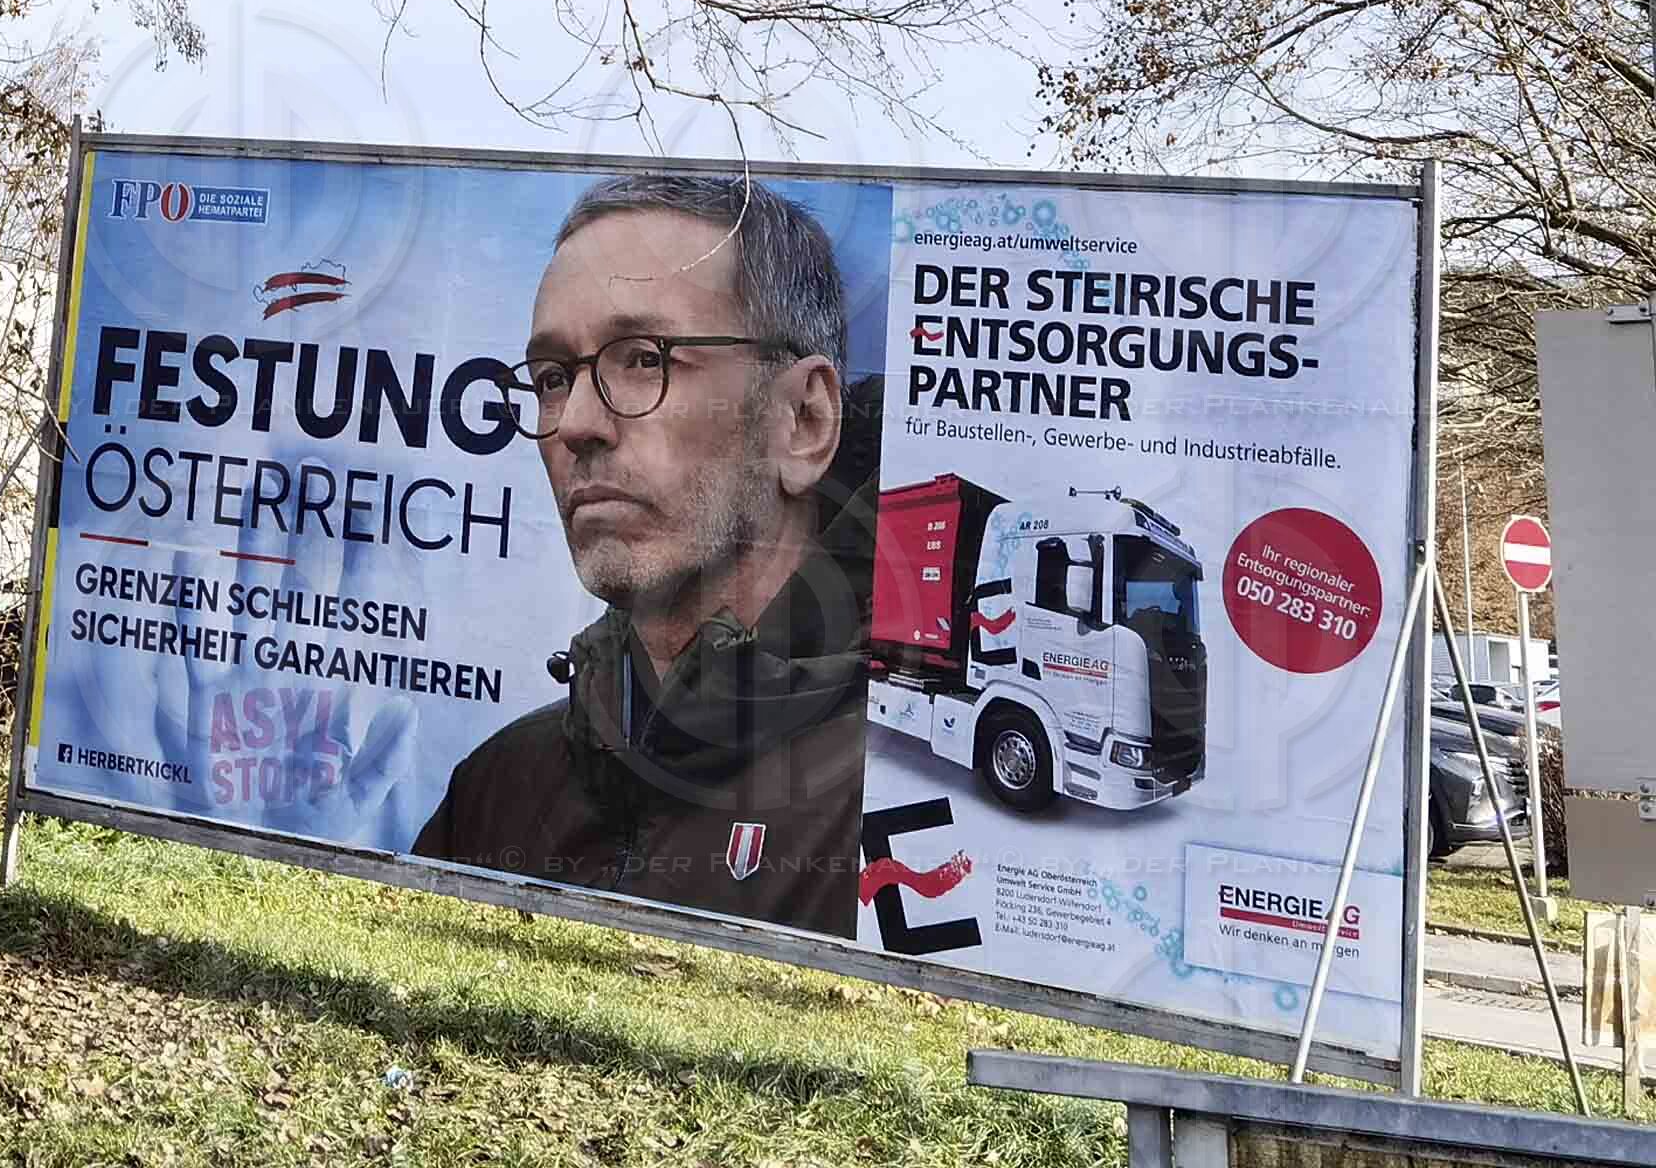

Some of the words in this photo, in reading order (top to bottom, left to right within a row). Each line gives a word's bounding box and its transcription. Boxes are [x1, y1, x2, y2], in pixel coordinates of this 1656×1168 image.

[198, 205, 264, 218] HEIMATPARTEI
[199, 193, 217, 204] DIE
[220, 194, 264, 206] SOZIALE
[913, 231, 1138, 256] energieag.at/umweltservice
[913, 264, 1009, 310] DER
[1026, 269, 1316, 326] STEIRISCHE
[911, 315, 1319, 380] ENTSORGUNGS-
[92, 326, 522, 456] FESTUNG
[908, 365, 1132, 421] PARTNER
[905, 417, 931, 437] für
[936, 420, 1038, 447] Baustellen-,
[1044, 427, 1135, 452] Gewerbe-
[1140, 436, 1178, 456] und
[1182, 438, 1342, 470] Industrieabfälle.
[85, 423, 513, 559] ÖSTERREICH
[1237, 552, 1372, 618] Entsorgungspartner:
[1261, 543, 1282, 563] Ihr
[1283, 557, 1356, 593] regionaler
[75, 562, 220, 613] GRENZEN
[227, 583, 428, 641] SCHLIESSEN
[1237, 575, 1275, 606] 050
[1276, 592, 1316, 623] 283
[1318, 609, 1357, 640] 310
[70, 609, 247, 665] SICHERHEIT
[253, 637, 503, 704] GARANTIEREN
[210, 687, 340, 756] ASYL
[77, 747, 193, 784] HERBERTKICKL
[996, 876, 1026, 887] Umwelt
[1028, 881, 1055, 892] Service
[1057, 885, 1082, 897] GmbH
[997, 864, 1025, 876] Energie
[1027, 869, 1039, 878] AG
[1041, 870, 1098, 888] Oberösterreich
[1219, 924, 1241, 936] Wir
[1243, 928, 1289, 946] denken
[1292, 938, 1308, 950] an
